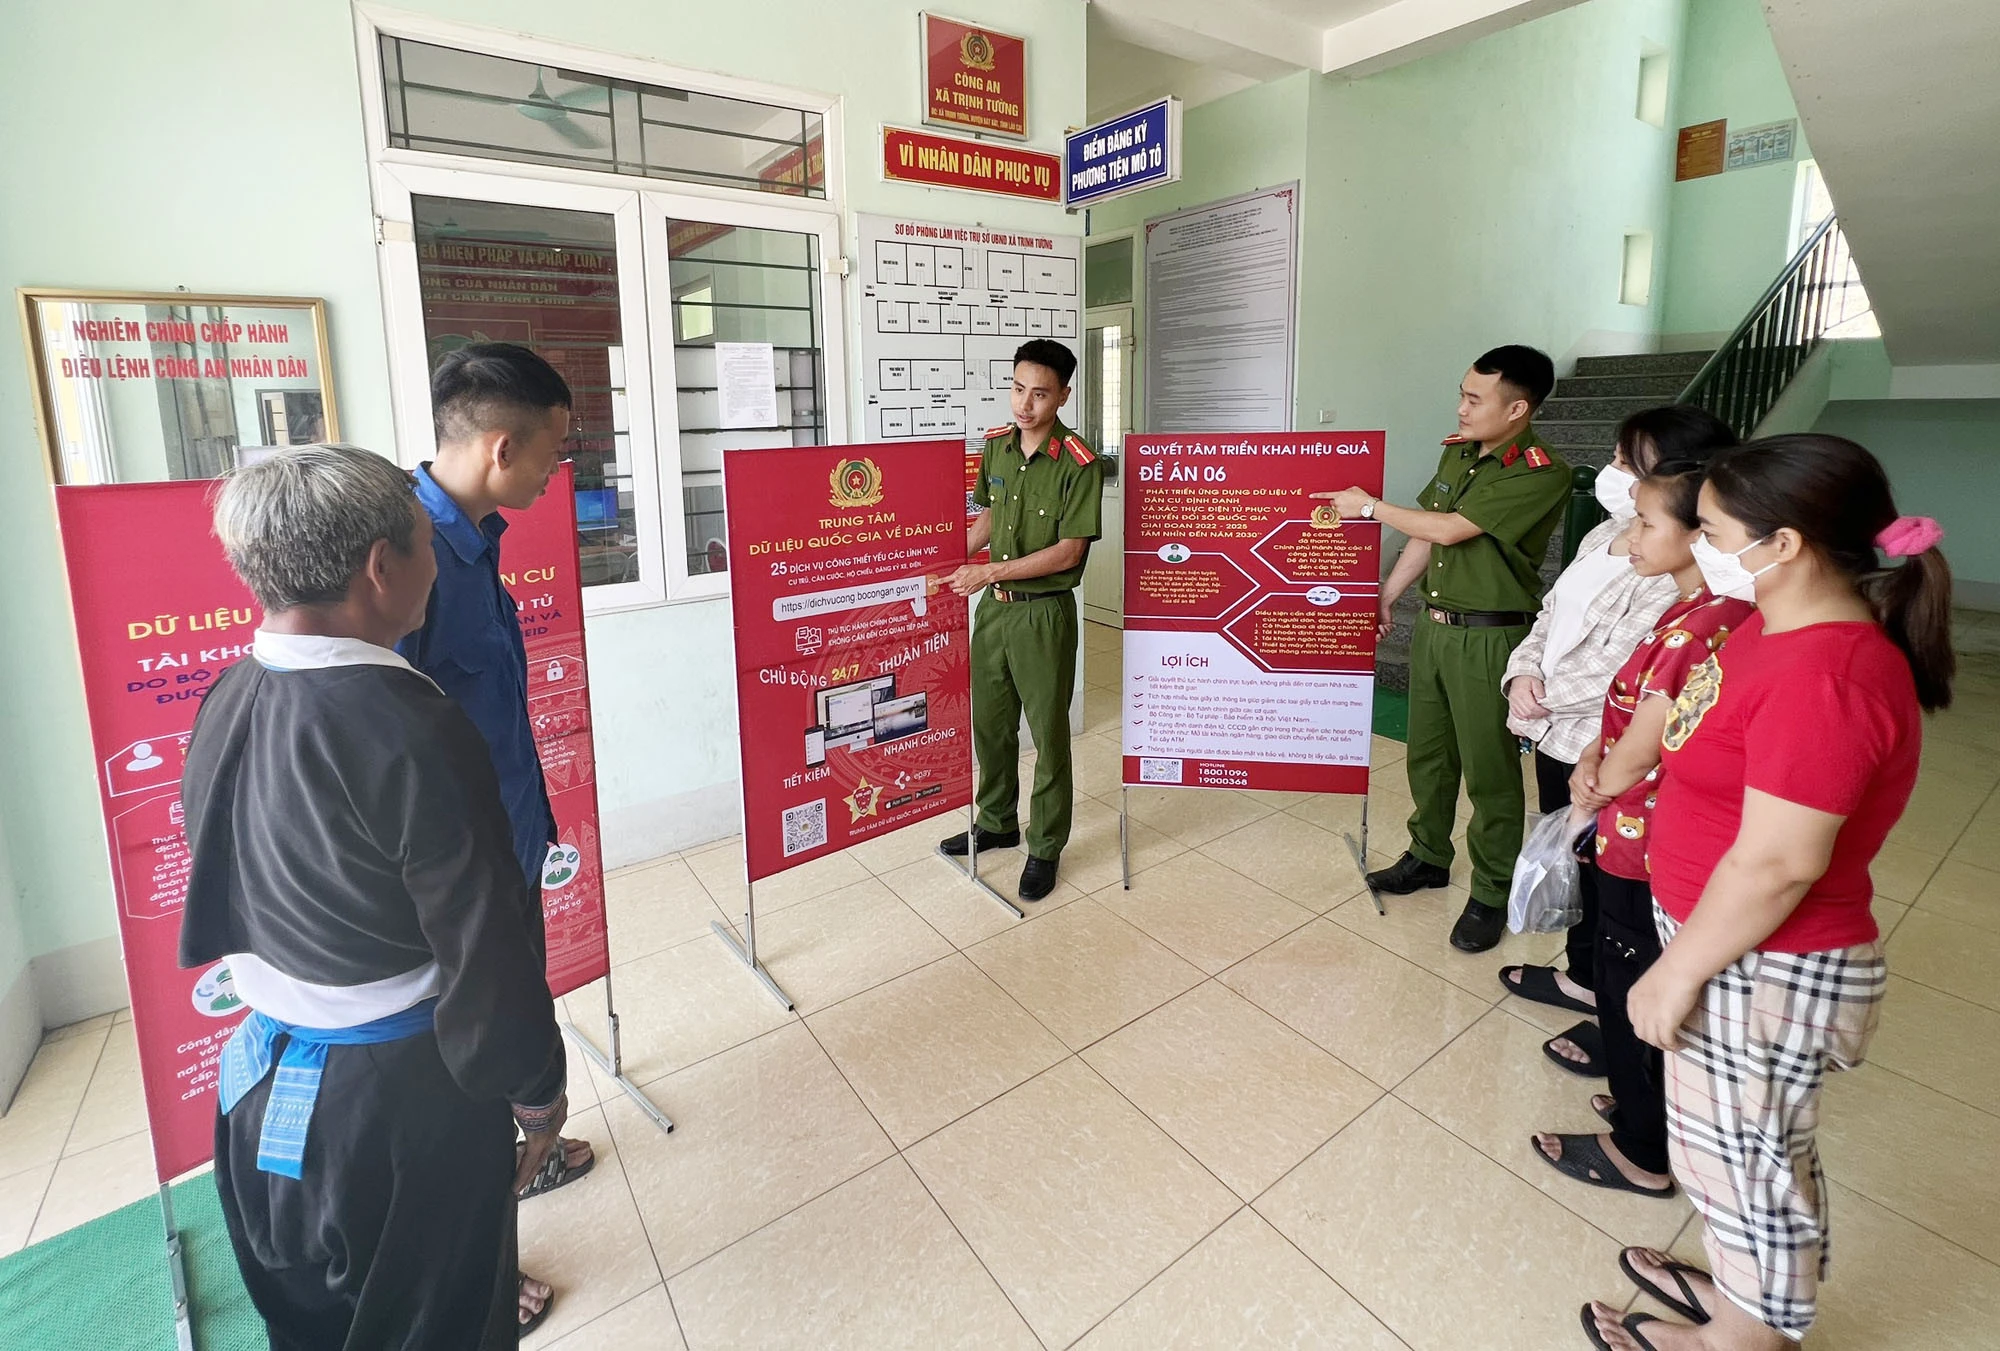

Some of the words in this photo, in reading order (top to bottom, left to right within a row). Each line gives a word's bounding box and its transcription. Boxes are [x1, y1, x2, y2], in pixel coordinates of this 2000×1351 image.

[954, 72, 983, 90] CÔNG
[986, 80, 1000, 94] AN
[936, 88, 950, 103] XÃ
[953, 92, 982, 110] TRỊNH
[986, 99, 1018, 116] TƯỜNG
[1083, 134, 1106, 162] ĐIỂM
[1107, 130, 1132, 154] ĐĂNG
[1134, 119, 1147, 144] KÝ
[899, 143, 914, 167] VÌ
[918, 144, 958, 173] NHÂN
[963, 151, 991, 178] DÂN
[995, 160, 1030, 187] PHỤC
[1034, 168, 1050, 191] VỤ
[1072, 164, 1106, 192] PHƯƠNG
[1108, 156, 1129, 182] TIỆN
[1131, 148, 1146, 174] MÔ
[1149, 142, 1162, 168] TÔ
[895, 223, 904, 235] SƠ
[916, 224, 937, 238] PHÒNG
[940, 226, 952, 239] LÀM
[954, 228, 968, 242] VIỆC
[969, 231, 981, 245] TRỤ
[991, 234, 1007, 245] UBND
[72, 317, 141, 342] NGHIÊM
[146, 315, 195, 344] CHÍNH
[200, 316, 242, 344] CHẤP
[248, 319, 288, 344] HÀNH
[61, 353, 101, 378] ĐIỀU
[107, 354, 150, 381] LỆNH
[154, 354, 198, 379] CÔNG
[204, 358, 226, 378] AN
[231, 355, 273, 378] NHÂN
[277, 355, 307, 378] DÂN
[1139, 442, 1184, 456] QUYẾT
[1186, 443, 1217, 456] TÂM
[1221, 440, 1257, 456] TRIỂN
[1262, 444, 1296, 456] KHAI
[1301, 442, 1332, 456] HIỆU
[1336, 440, 1370, 456] QUẢ
[1139, 461, 1163, 482] ĐỀ
[1169, 461, 1198, 482] ÁN
[1204, 466, 1227, 482] 06
[1146, 488, 1168, 496] PHÁT
[1171, 487, 1195, 496] TRIỂN
[1222, 489, 1250, 497] DỤNG
[819, 516, 864, 529] TRUNG
[868, 512, 895, 524] TÂM
[749, 540, 771, 555] DỮ
[775, 538, 803, 553] LIỆU
[808, 532, 852, 548] QUỐC
[856, 532, 882, 543] GIA
[886, 525, 901, 539] VỀ
[905, 524, 933, 537] DÂN
[936, 522, 953, 533] CƯ
[770, 562, 787, 576] 25
[789, 563, 810, 574] DỊCH
[812, 562, 824, 571] VỤ
[826, 558, 851, 568] CÔNG
[852, 552, 871, 565] THIẾT
[872, 551, 886, 562] YẾU
[888, 550, 905, 560] CÁC
[906, 547, 922, 558] LĨNH
[923, 546, 938, 556] VỰC
[524, 566, 555, 583] CƯ
[530, 593, 554, 608] TỬ
[781, 583, 920, 613] https://dichvucong.bocongan.gov.vn
[127, 614, 179, 640] DỮ
[189, 608, 252, 631] LIỆU
[540, 609, 562, 620] VÀ
[137, 652, 189, 672] TÀI
[879, 645, 920, 673] THUẬN
[924, 632, 949, 654] TIỆN
[1162, 654, 1182, 669] LỢI
[1186, 653, 1209, 667] ÍCH
[127, 678, 167, 692] DO
[176, 669, 211, 684] BỘ
[759, 665, 787, 685] CHỦ
[790, 670, 827, 688] ĐỘNG
[832, 664, 859, 681] 24/7
[884, 739, 918, 756] NHANH
[920, 728, 956, 746] CHÓNG
[783, 771, 802, 789] TIẾT
[805, 767, 830, 784] KIỆM
[1199, 768, 1248, 777] 18001096
[1199, 777, 1248, 786] 19000368
[177, 1036, 211, 1054] Công
[177, 1064, 197, 1078] nơi
